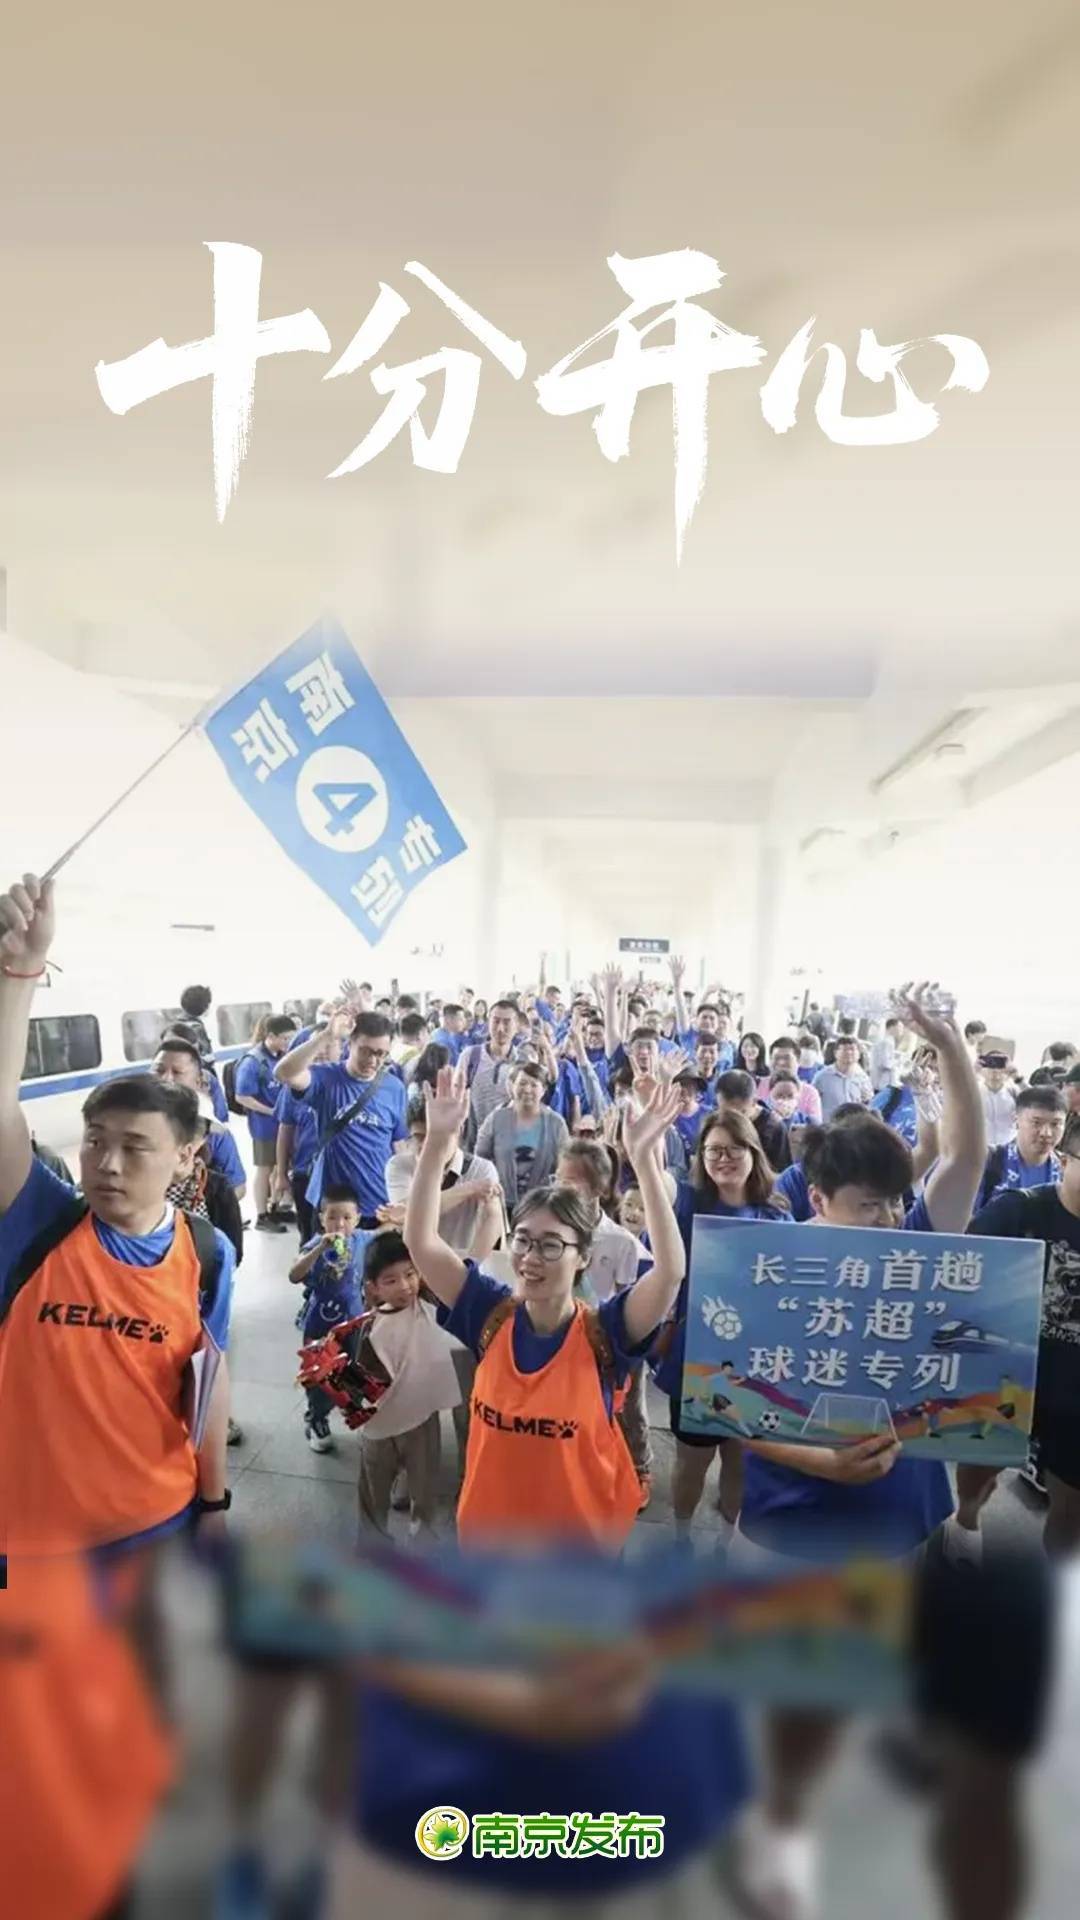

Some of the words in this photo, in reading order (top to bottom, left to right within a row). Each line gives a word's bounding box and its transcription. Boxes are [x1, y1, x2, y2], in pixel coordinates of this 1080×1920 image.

[230, 651, 355, 784] 南京
[312, 782, 379, 837] 4
[751, 1248, 985, 1293] 长三角首趟
[37, 1301, 150, 1341] KELME
[776, 1295, 947, 1342] “苏超”
[746, 1344, 962, 1392] 球迷专列
[473, 1397, 557, 1440] KELME
